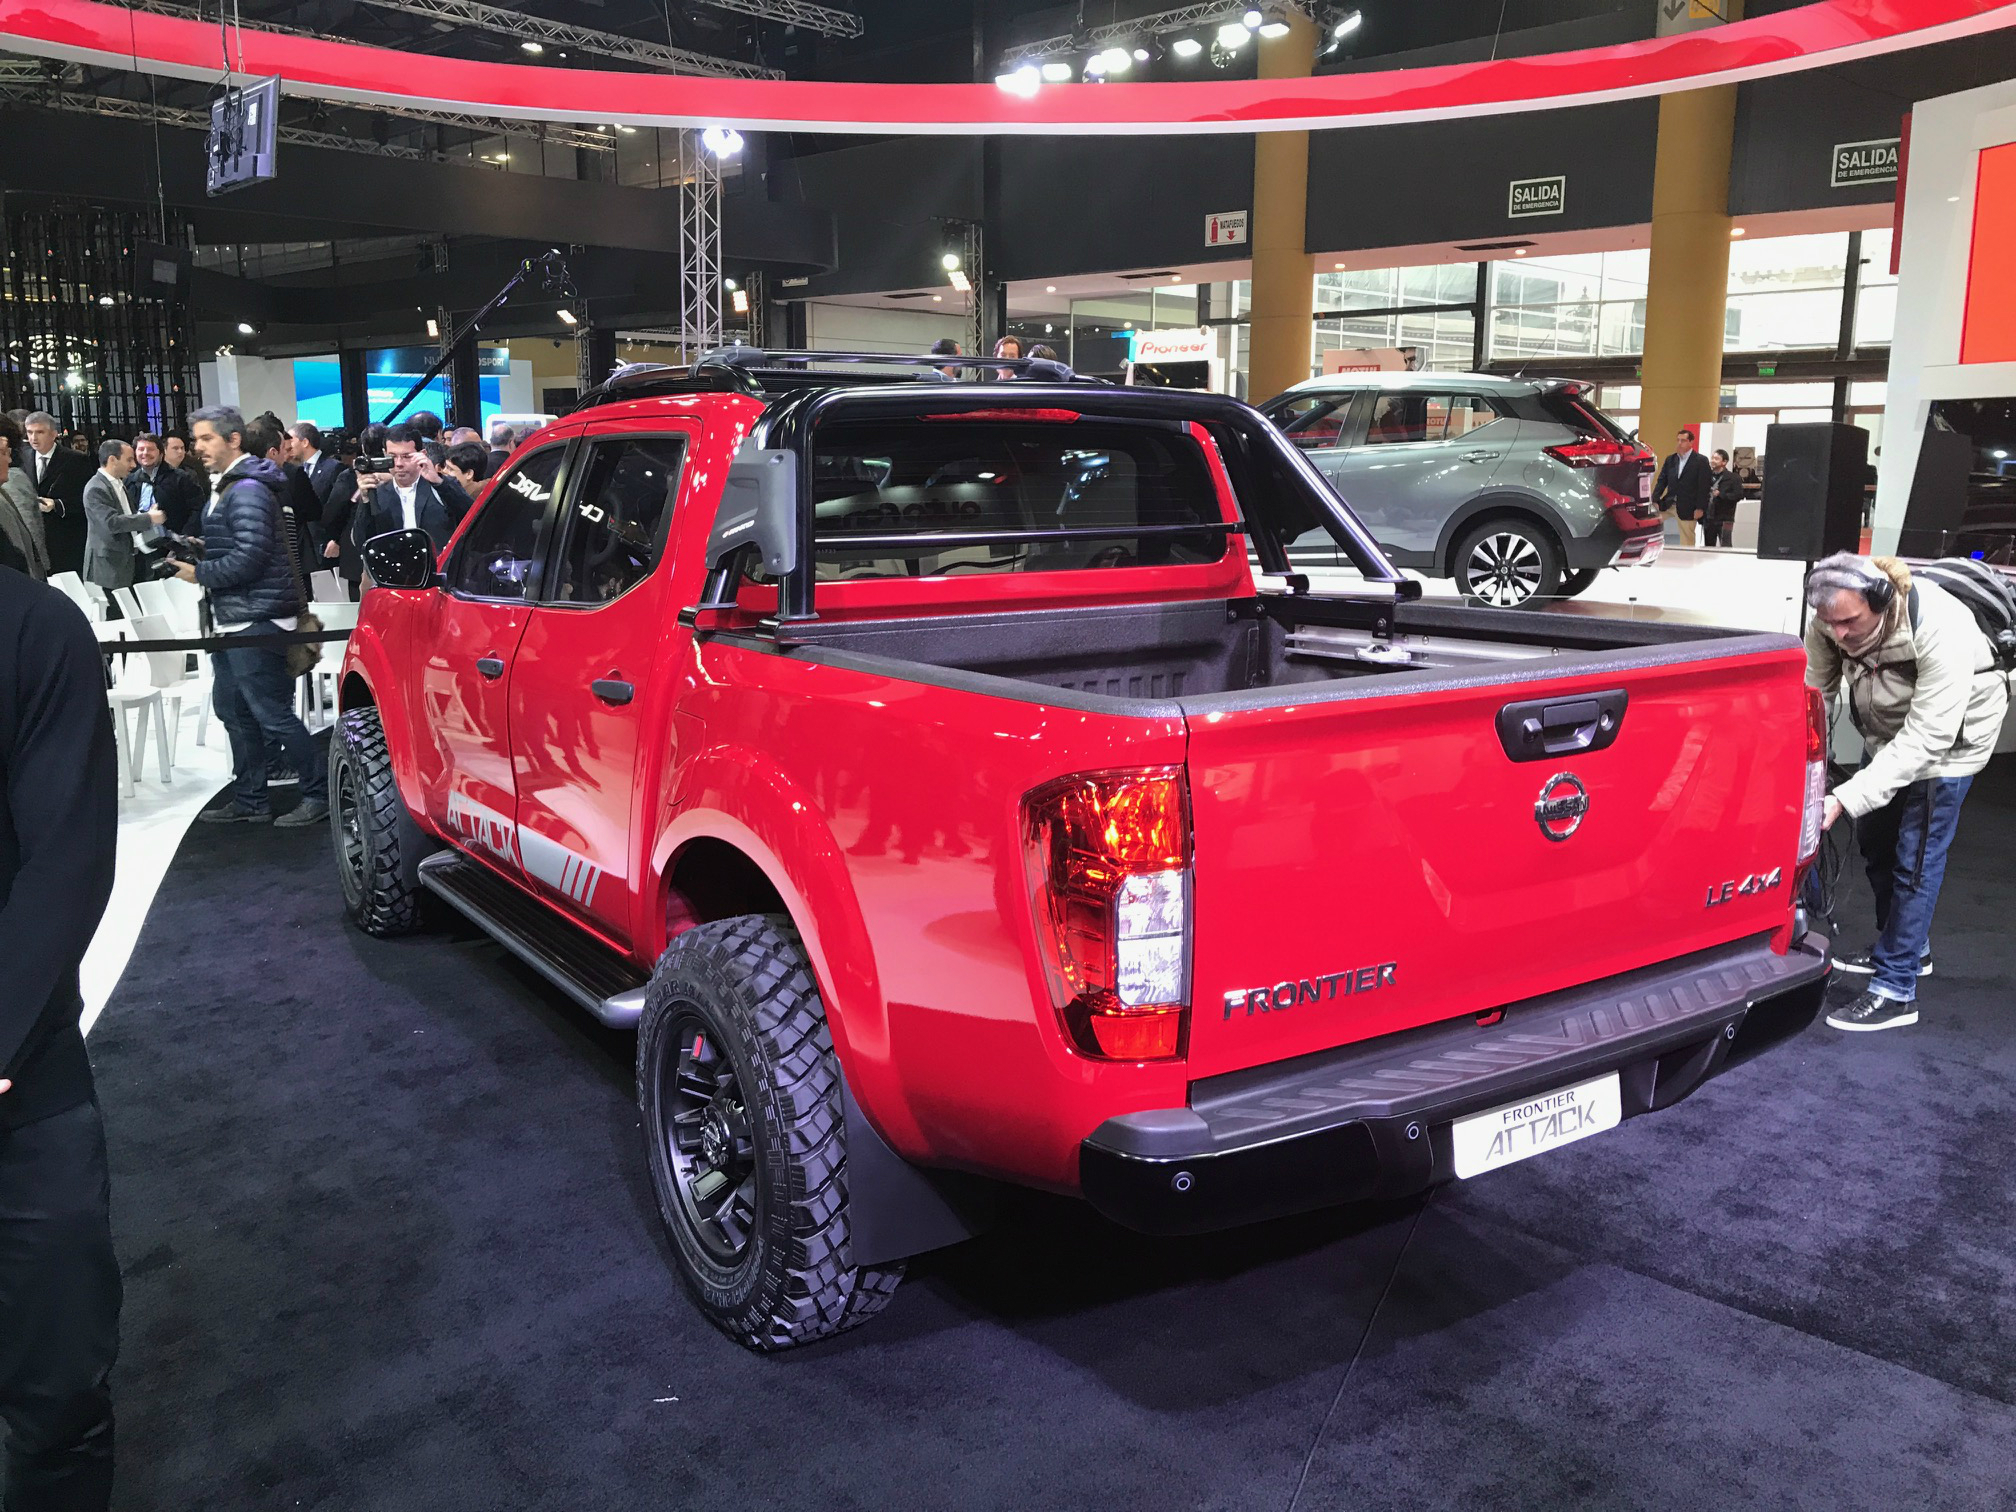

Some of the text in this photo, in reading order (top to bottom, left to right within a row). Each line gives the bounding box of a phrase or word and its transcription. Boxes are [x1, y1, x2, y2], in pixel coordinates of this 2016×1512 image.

[1838, 147, 1898, 169] SALIDA
[1837, 165, 1898, 178] DE EMERGENCIA
[1514, 184, 1559, 203] SALIDA
[1522, 200, 1559, 210] EMERGENCIA
[1219, 218, 1245, 230] MATAFUEGOS
[1140, 341, 1208, 355] Pioneer
[1539, 796, 1588, 816] NISSAN
[447, 790, 521, 870] ATTACK
[1705, 880, 1735, 908] LE
[1223, 961, 1397, 1020] FRONTIER
[1503, 1091, 1575, 1124] FRONTIER
[1485, 1100, 1596, 1161] ATTACK
